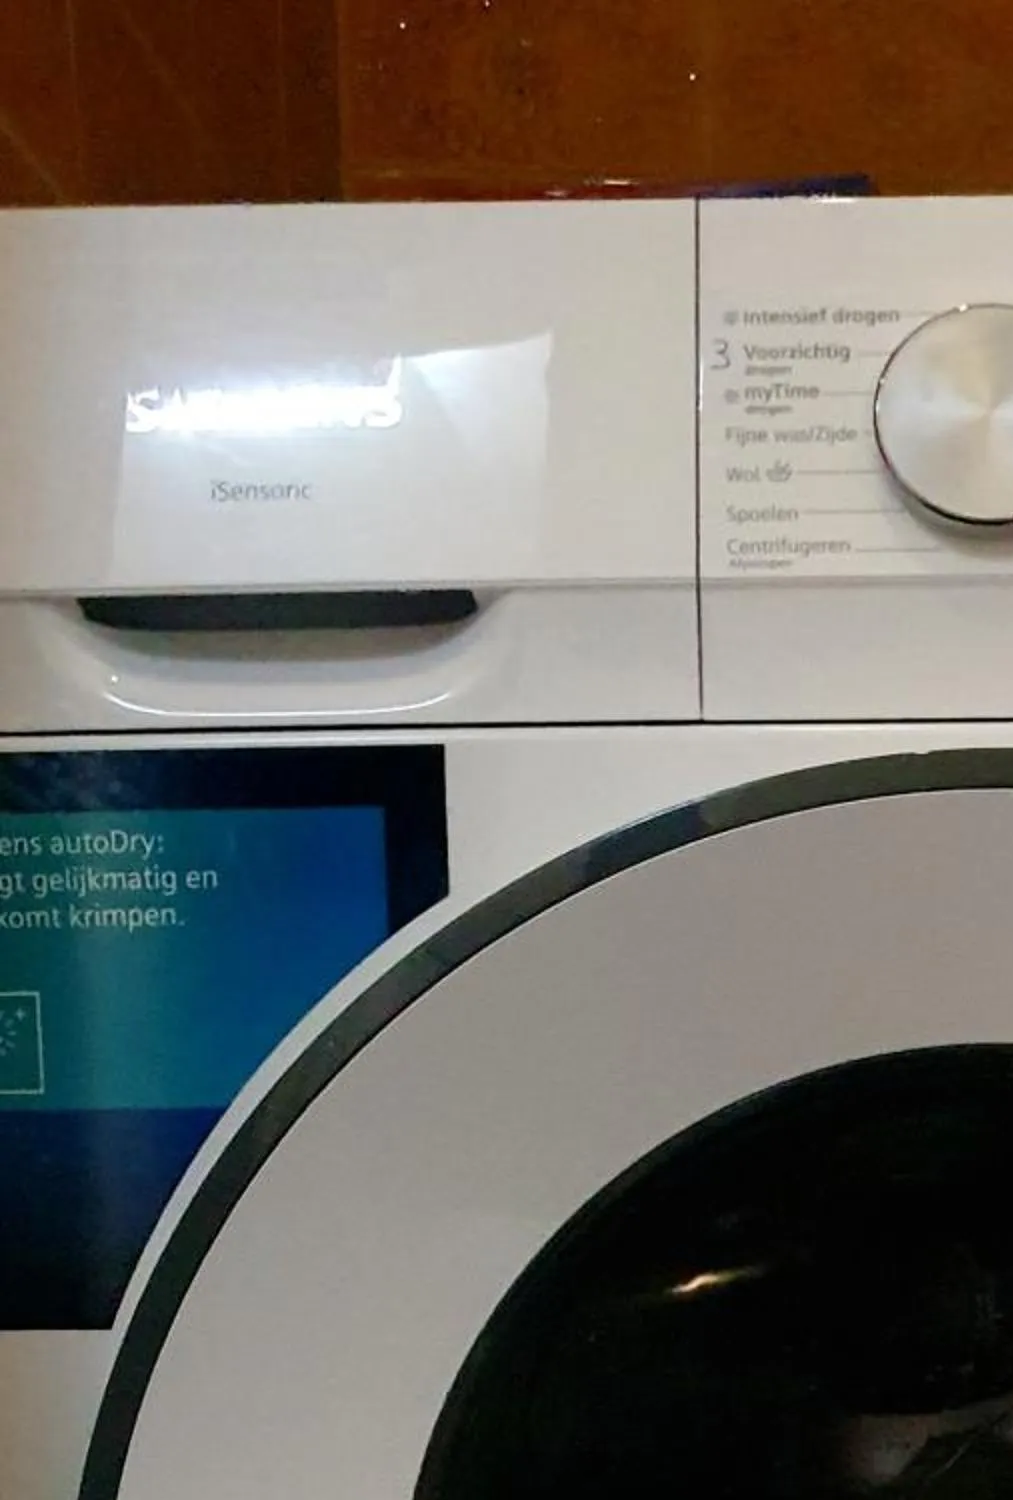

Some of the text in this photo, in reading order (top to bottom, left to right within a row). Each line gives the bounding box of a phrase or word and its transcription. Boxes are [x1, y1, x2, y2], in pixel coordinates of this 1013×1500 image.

[743, 308, 900, 327] Intensief drogen
[710, 338, 732, 371] 3
[743, 344, 851, 363] Voorzichtig
[743, 383, 820, 402] myTime
[725, 427, 769, 447] Fijne
[726, 467, 761, 483] Wol
[210, 480, 312, 503] iSensoric
[726, 505, 799, 524] Spoelen
[727, 537, 851, 557] Centrifugeren
[51, 830, 164, 861] autoDry:
[31, 864, 178, 900] gelijkmatig
[186, 869, 219, 889] en
[69, 903, 187, 935] krimpen.
